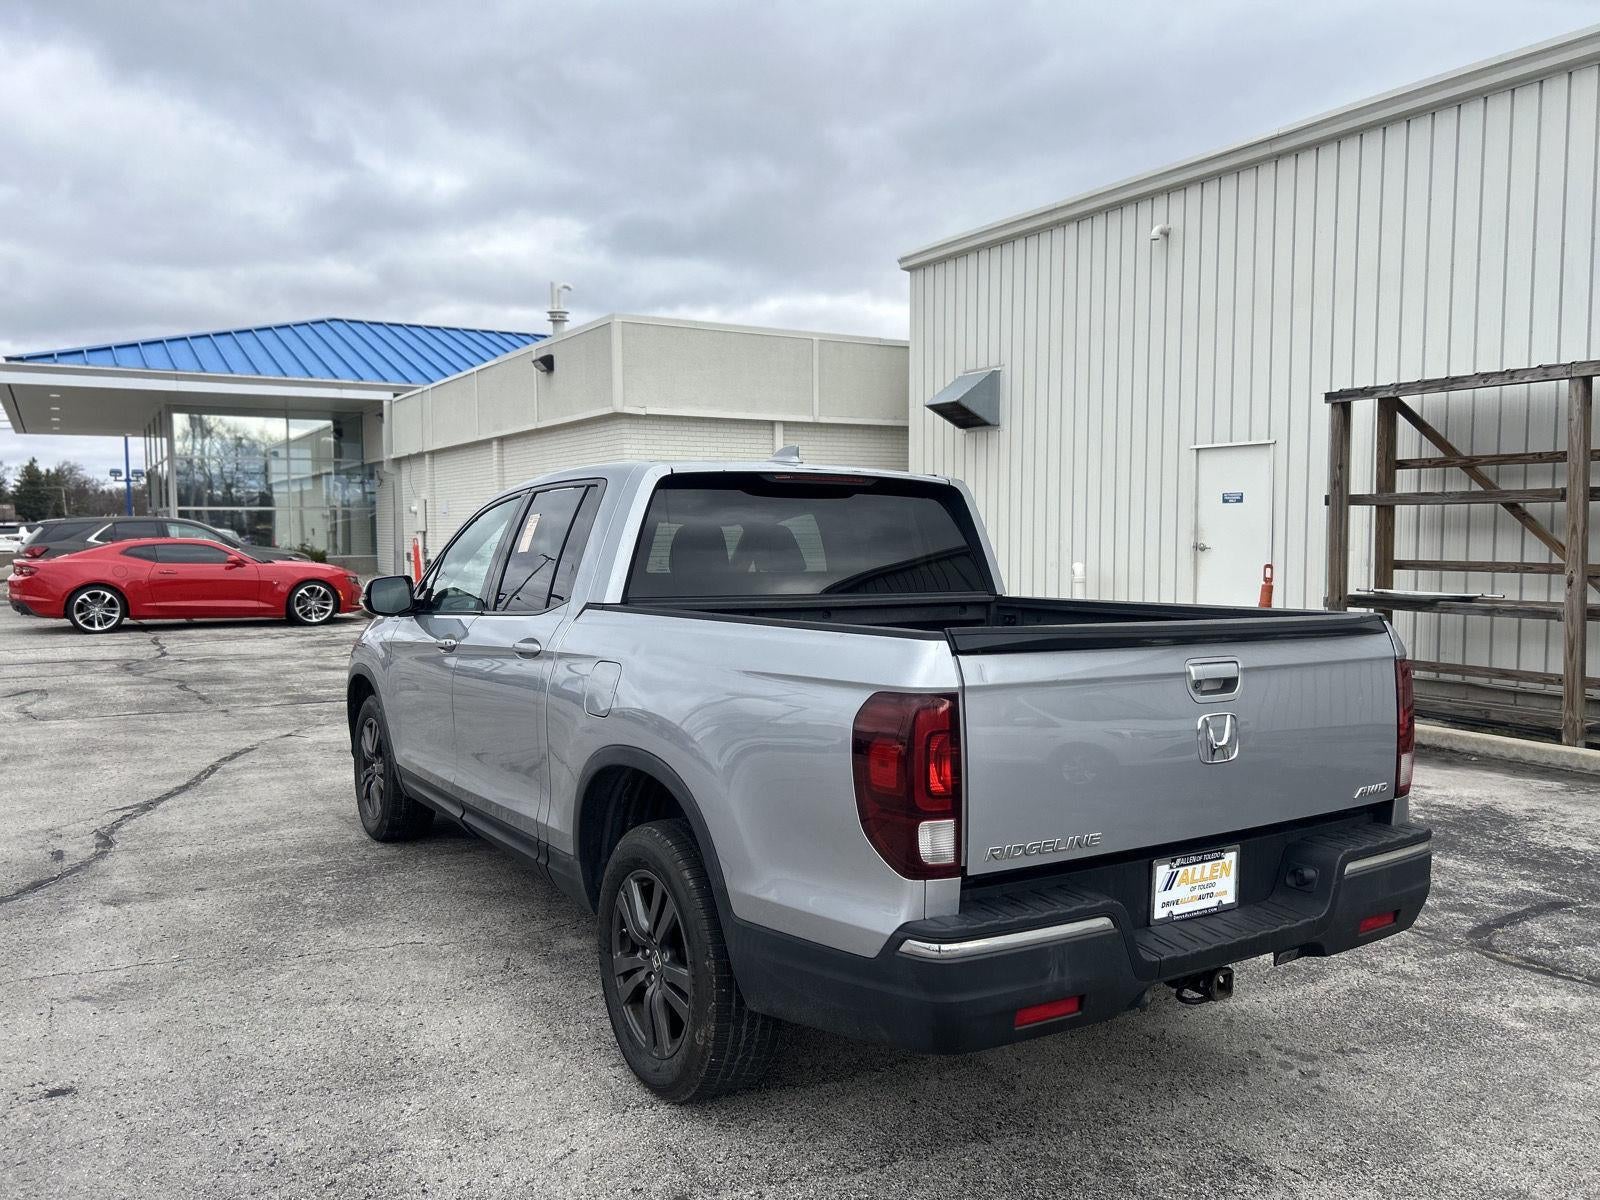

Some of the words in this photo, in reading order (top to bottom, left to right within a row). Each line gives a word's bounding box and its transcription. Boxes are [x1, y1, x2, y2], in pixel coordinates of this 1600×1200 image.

[1353, 782, 1388, 799] AWD
[984, 832, 1102, 862] RIDGELINE
[1179, 856, 1196, 865] ALLEN
[1203, 852, 1221, 861] TOLEDO
[1177, 860, 1232, 887] ALLEN
[1189, 885, 1197, 893] OF
[1197, 881, 1217, 891] TOLEDO
